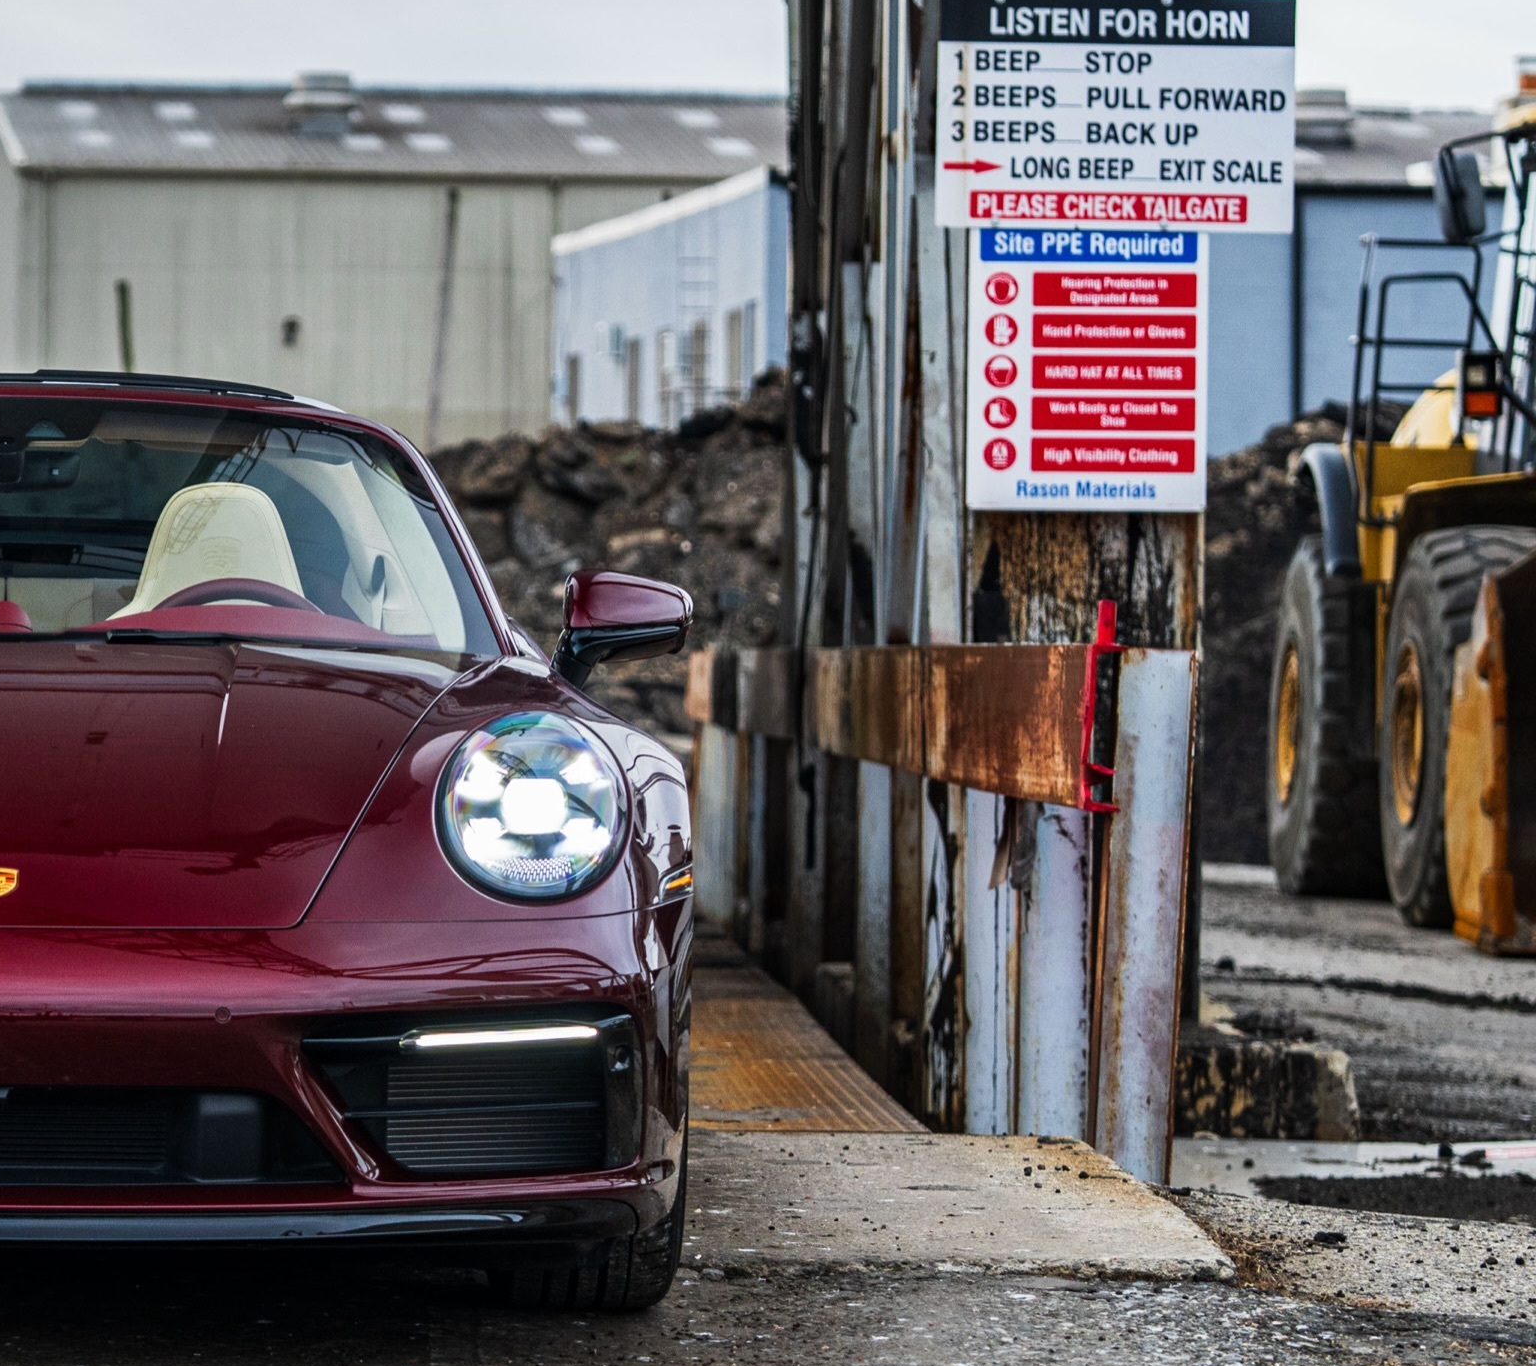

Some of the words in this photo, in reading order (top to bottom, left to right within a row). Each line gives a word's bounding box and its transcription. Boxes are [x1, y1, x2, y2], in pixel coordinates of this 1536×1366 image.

[990, 7, 1090, 36] LISTEN
[1098, 9, 1157, 38] FOR
[1165, 9, 1250, 39] HORN
[954, 50, 965, 72] 1
[975, 50, 1040, 73] BEEP
[1085, 52, 1152, 74] STOP
[952, 85, 965, 106] 2
[975, 85, 1056, 108] BEEPS
[1087, 87, 1150, 110] PULL
[1159, 88, 1286, 112] FORWARD
[952, 121, 965, 143] 3
[974, 121, 1056, 144] BEEPS
[1086, 123, 1156, 145] BACK
[1165, 124, 1198, 146] UP
[1011, 157, 1070, 179] LONG
[1078, 158, 1134, 180] BEEP
[1160, 159, 1206, 182] EXIT
[1213, 161, 1283, 183] SCALE
[976, 193, 1057, 218] PLEASE
[1064, 195, 1136, 219] CHECK
[1141, 196, 1242, 221] TAILGATE
[994, 232, 1035, 255] Site
[1041, 233, 1083, 255] PPE
[1090, 234, 1184, 260] Required
[1061, 276, 1102, 291] Hearing
[1104, 277, 1155, 290] Protection
[1157, 277, 1168, 290] in
[1070, 292, 1127, 306] Designated
[1129, 292, 1159, 305] Areas
[1042, 324, 1072, 337] Hand
[1075, 324, 1131, 338] Protection
[1133, 327, 1145, 338] or
[1148, 325, 1186, 339] Gloves
[1045, 366, 1078, 379] HARD
[1080, 366, 1103, 380] HAT
[1105, 366, 1119, 380] AT
[1122, 366, 1143, 380] ALL
[1147, 366, 1183, 380] TIMES
[1049, 402, 1076, 414] Work
[1078, 402, 1107, 414] Boots
[1123, 402, 1158, 415] Closed
[1160, 402, 1178, 415] Toe
[1044, 448, 1072, 464] High
[1075, 448, 1127, 465] Visibility
[1129, 448, 1179, 466] Clothing
[1017, 480, 1070, 498] Rason
[1076, 481, 1157, 499] Materials
